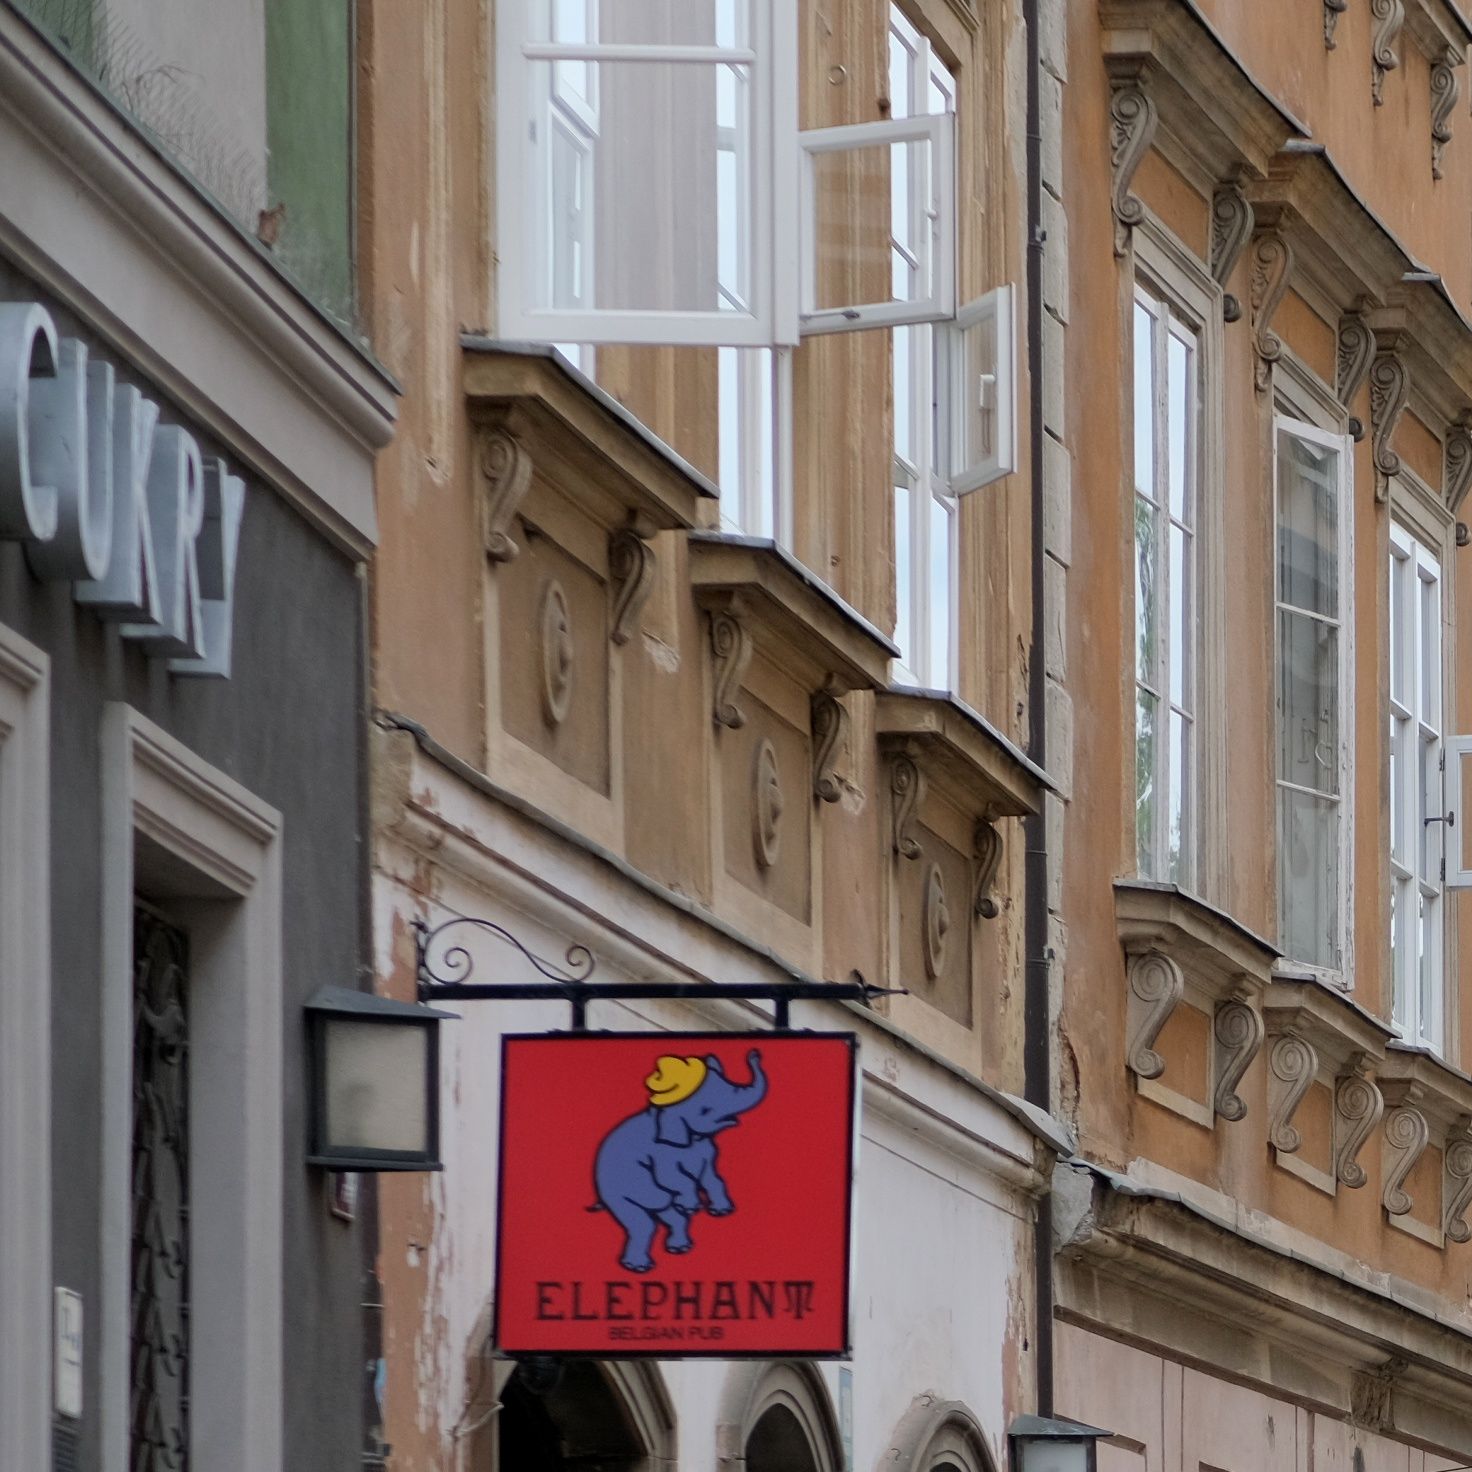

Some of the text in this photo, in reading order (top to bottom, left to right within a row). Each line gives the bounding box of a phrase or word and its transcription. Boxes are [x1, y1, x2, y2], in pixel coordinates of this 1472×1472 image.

[0, 301, 246, 680] CUKRY
[535, 1280, 815, 1321] ELEPHANT
[607, 1325, 725, 1341] BELGIAN PUB
